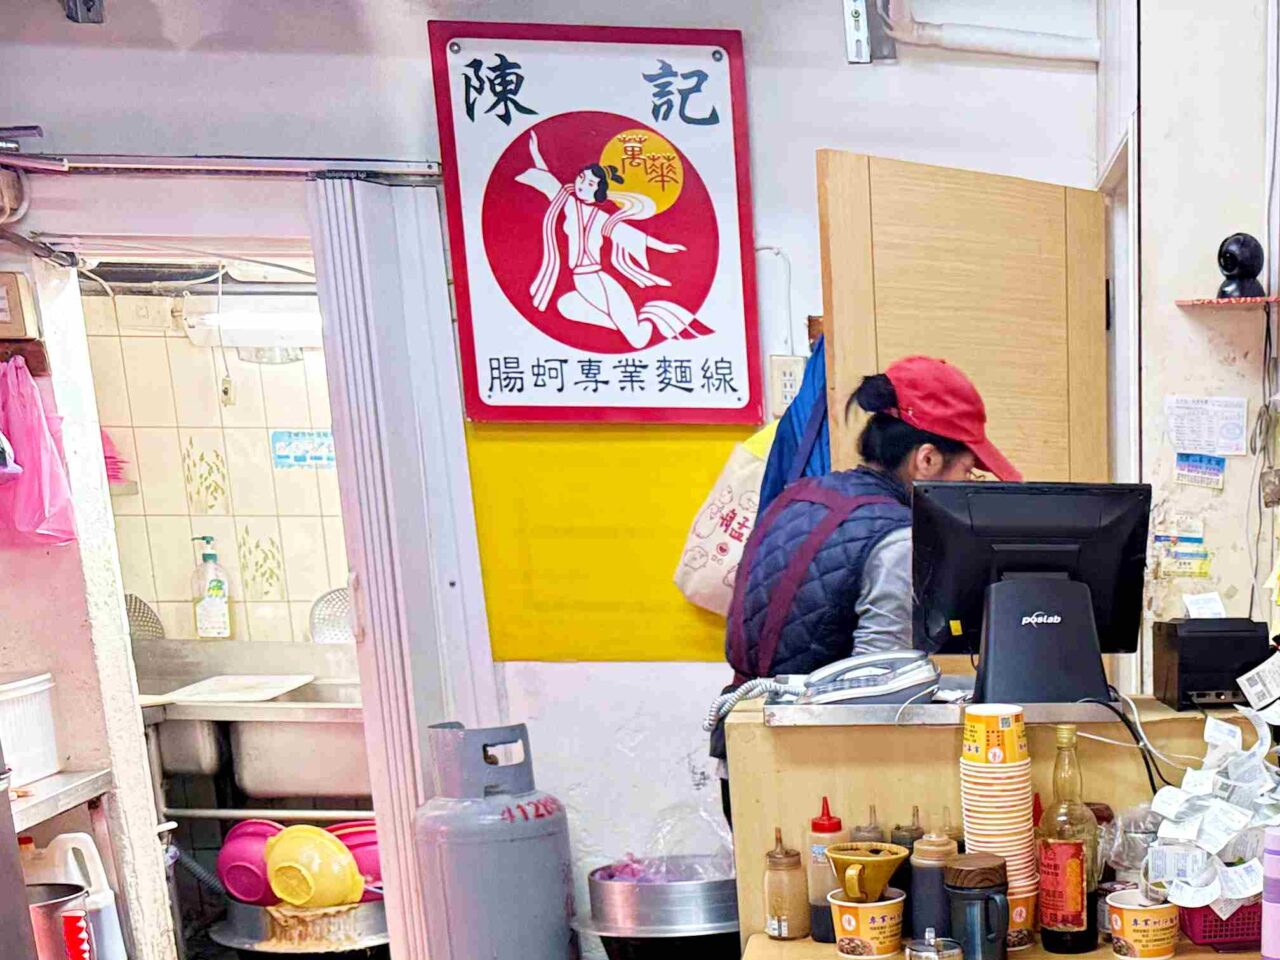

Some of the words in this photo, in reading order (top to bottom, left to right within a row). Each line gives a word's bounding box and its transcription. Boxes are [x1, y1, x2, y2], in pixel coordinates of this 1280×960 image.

[462, 53, 539, 126] 陳
[642, 60, 719, 125] 記
[617, 134, 680, 192] 萬華
[488, 356, 739, 394] 腸蚵專業麵線
[1021, 611, 1062, 628] poslab
